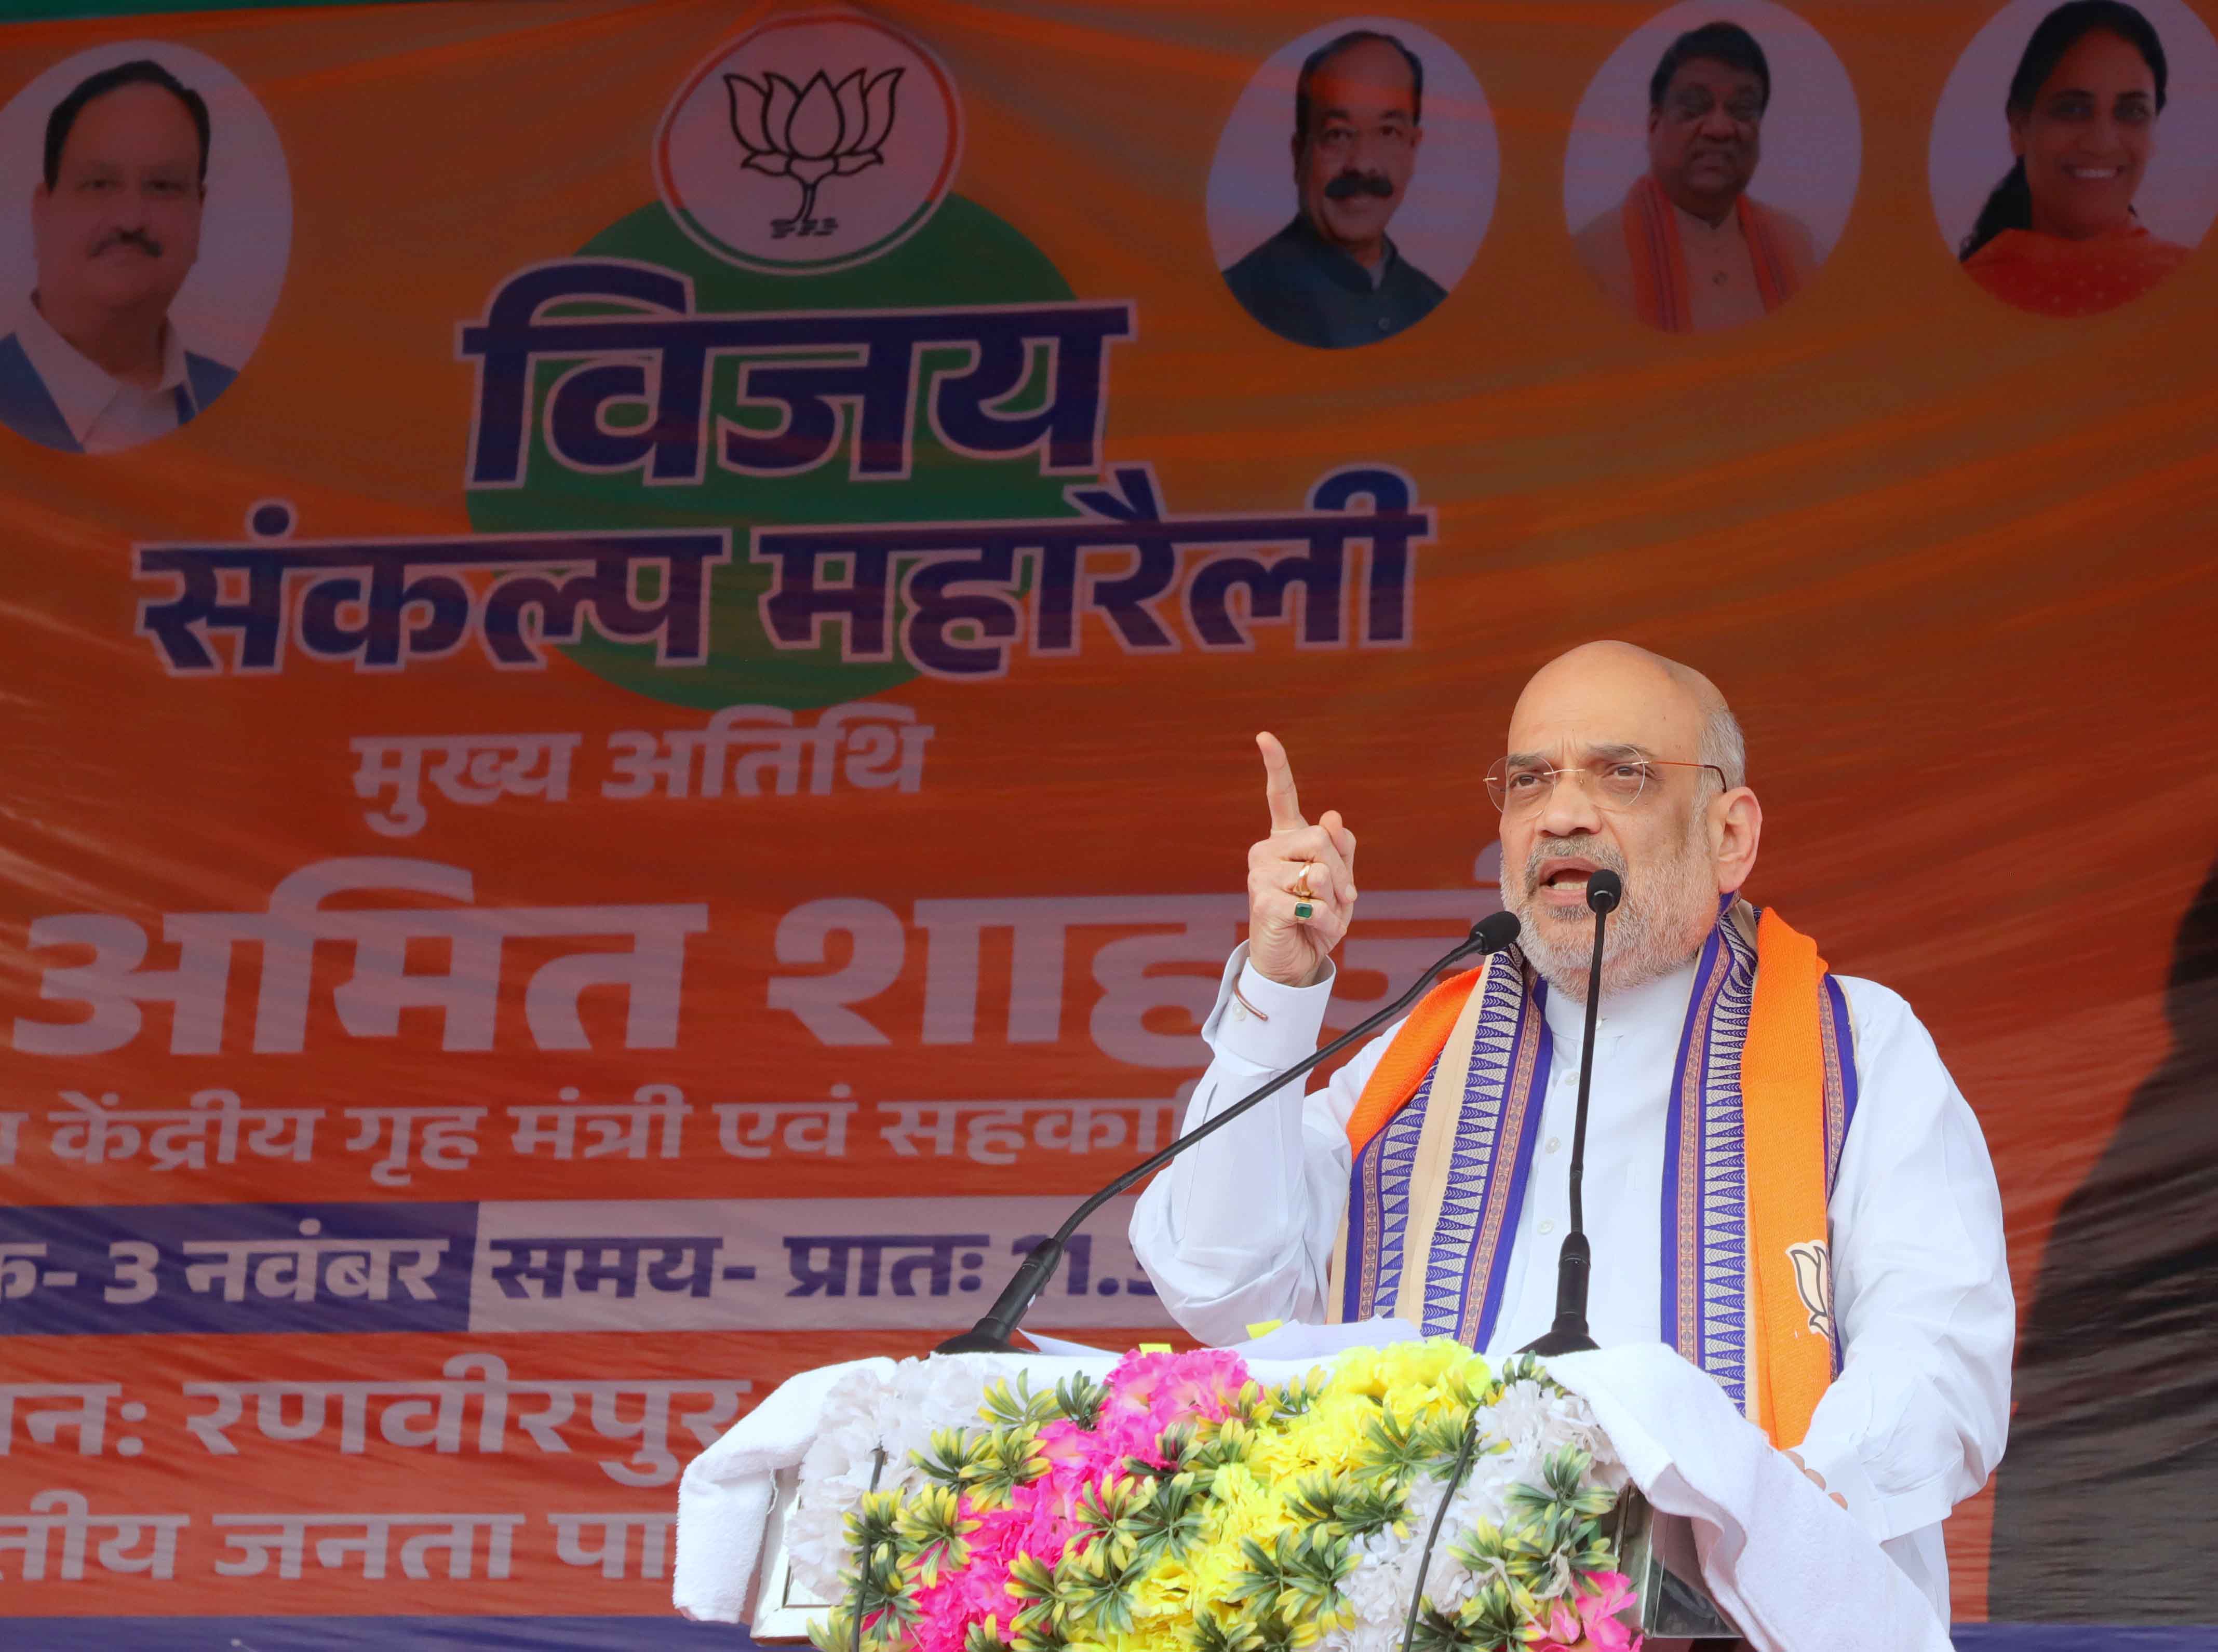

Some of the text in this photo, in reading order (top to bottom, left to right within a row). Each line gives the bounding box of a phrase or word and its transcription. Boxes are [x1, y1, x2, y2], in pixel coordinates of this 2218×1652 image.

[454, 255, 1138, 490] विजय
[131, 461, 1437, 683] संकल्प महारैली
[349, 702, 934, 837] मुख्य अतिथि
[10, 856, 709, 1055] अमित
[766, 892, 1253, 1067] शाह
[47, 1089, 325, 1172] केंद्रीय
[343, 1106, 488, 1186] गृह
[506, 1084, 692, 1161] मंत्री
[711, 1082, 858, 1159] एवं
[104, 1241, 160, 1304] 3
[183, 1218, 450, 1302] नवंबर
[490, 1236, 756, 1298] समय-
[783, 1234, 990, 1298] प्रातः
[183, 1352, 752, 1487] रणवीरपुर
[213, 1513, 525, 1580] जनता
